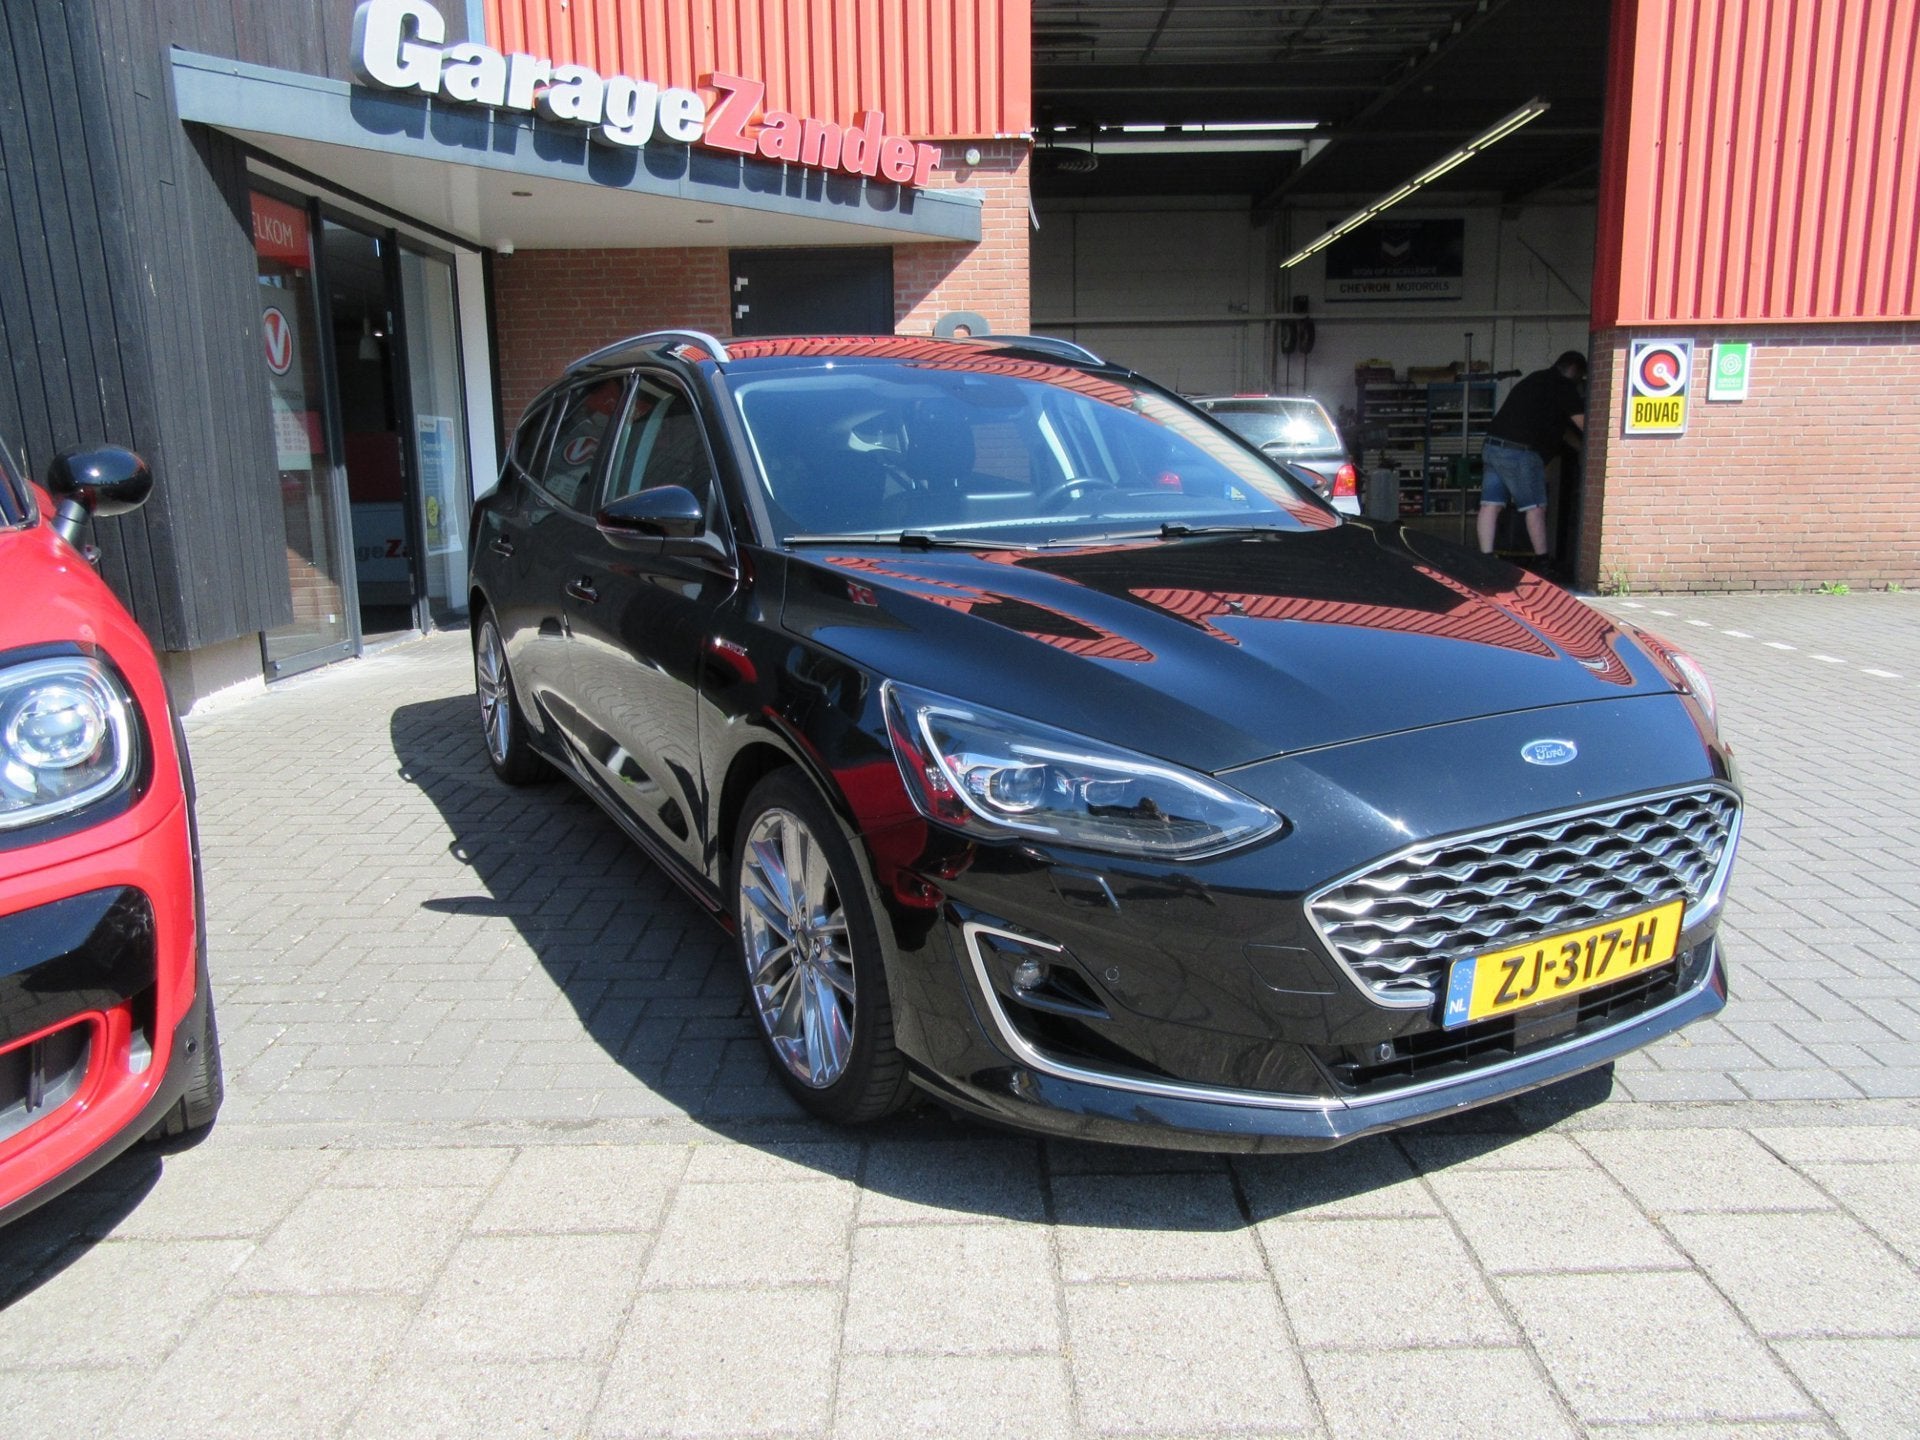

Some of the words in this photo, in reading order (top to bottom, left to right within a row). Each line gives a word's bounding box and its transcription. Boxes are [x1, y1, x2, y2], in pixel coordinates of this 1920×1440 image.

[1340, 282, 1390, 293] CHEVRON
[1396, 281, 1449, 292] MOTOROILS
[1635, 402, 1680, 423] BOVAG
[1535, 744, 1566, 760] Ford
[1493, 916, 1658, 1008] ZJ-317-H
[1449, 1000, 1466, 1014] NL
